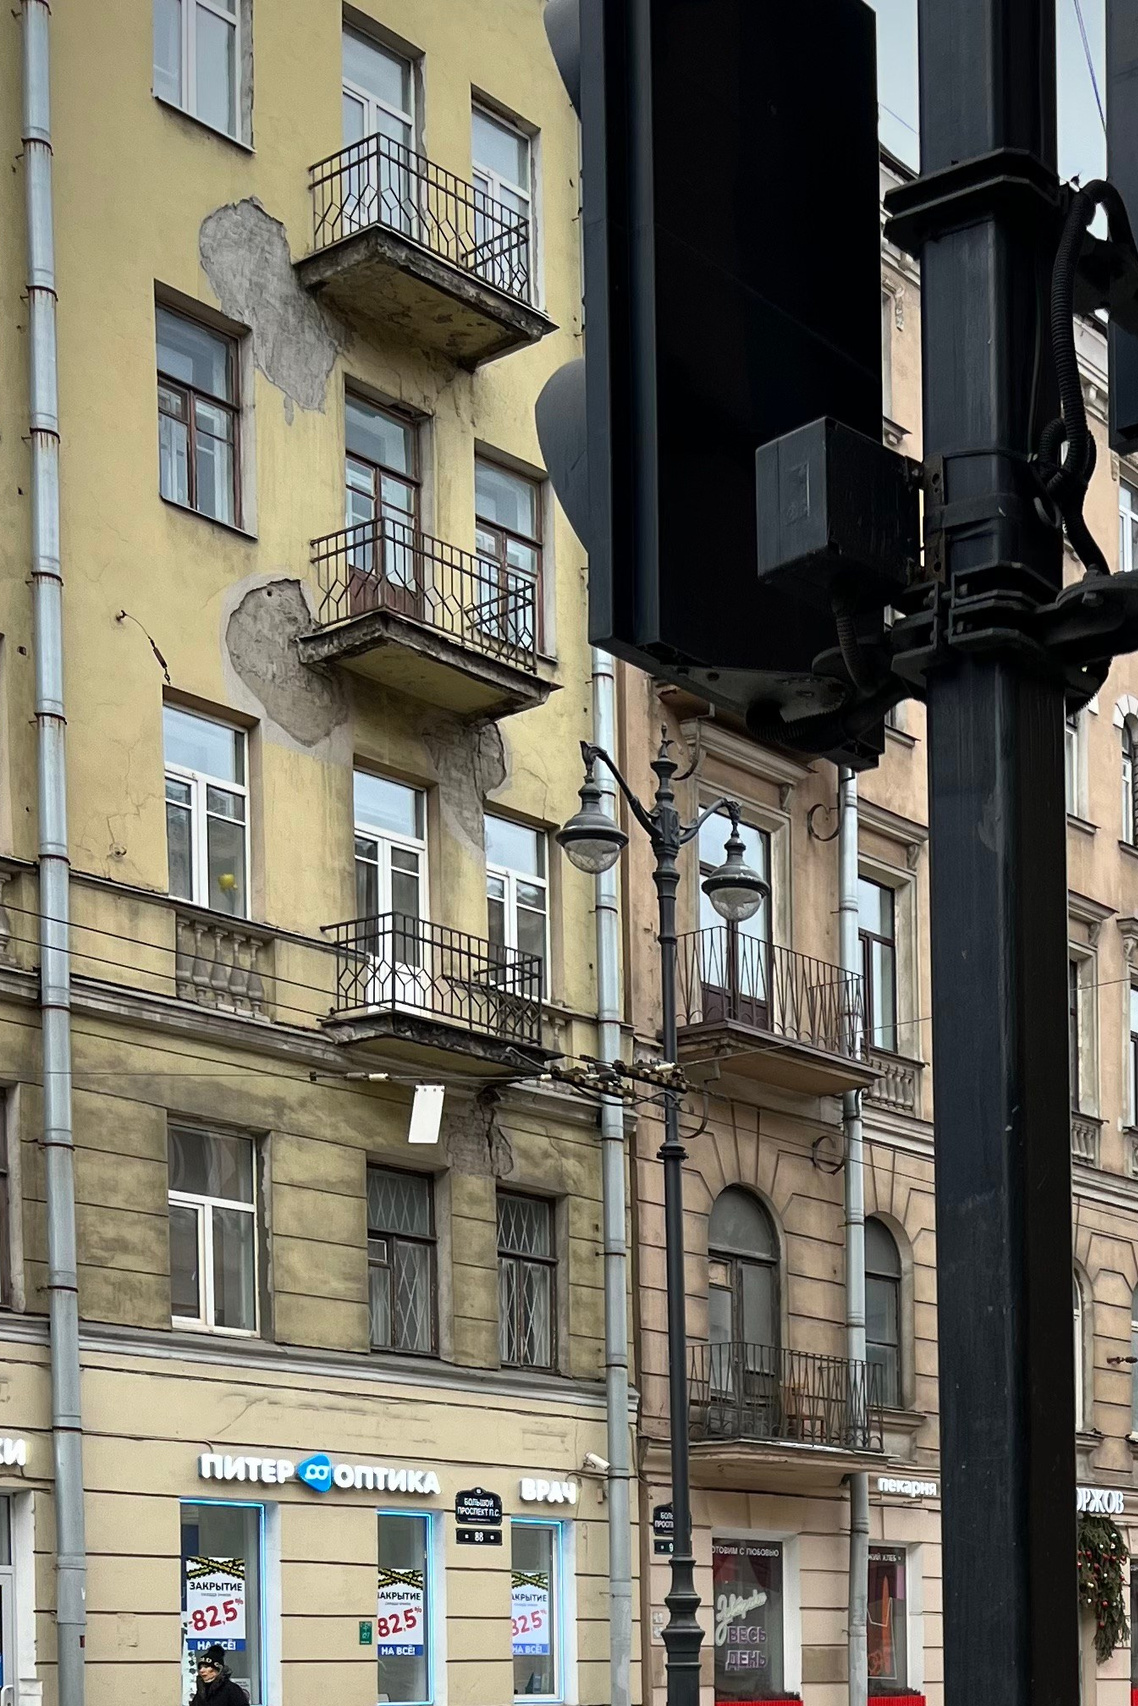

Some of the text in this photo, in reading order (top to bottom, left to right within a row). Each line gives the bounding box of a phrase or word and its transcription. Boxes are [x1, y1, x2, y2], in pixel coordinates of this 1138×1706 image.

[200, 1453, 442, 1495] ПИТЕР ОПТИКА
[520, 1477, 577, 1505] ВРАЧ
[877, 1477, 937, 1498] пекарня
[463, 1497, 494, 1508] БОЛЬШОЙ
[457, 1506, 489, 1517] ПРОСПЕКТ
[711, 1545, 738, 1555] ОТОВИМ
[189, 1581, 243, 1592] ЗАКРЫТИЕ
[378, 1591, 421, 1601] АКРЫТИЕ
[727, 1625, 767, 1644] ВЕСЬ
[197, 1640, 212, 1651] НА
[381, 1644, 416, 1656] НА ВСЁ!
[512, 1645, 524, 1654] НА
[725, 1649, 767, 1671] ДЕНЬ
